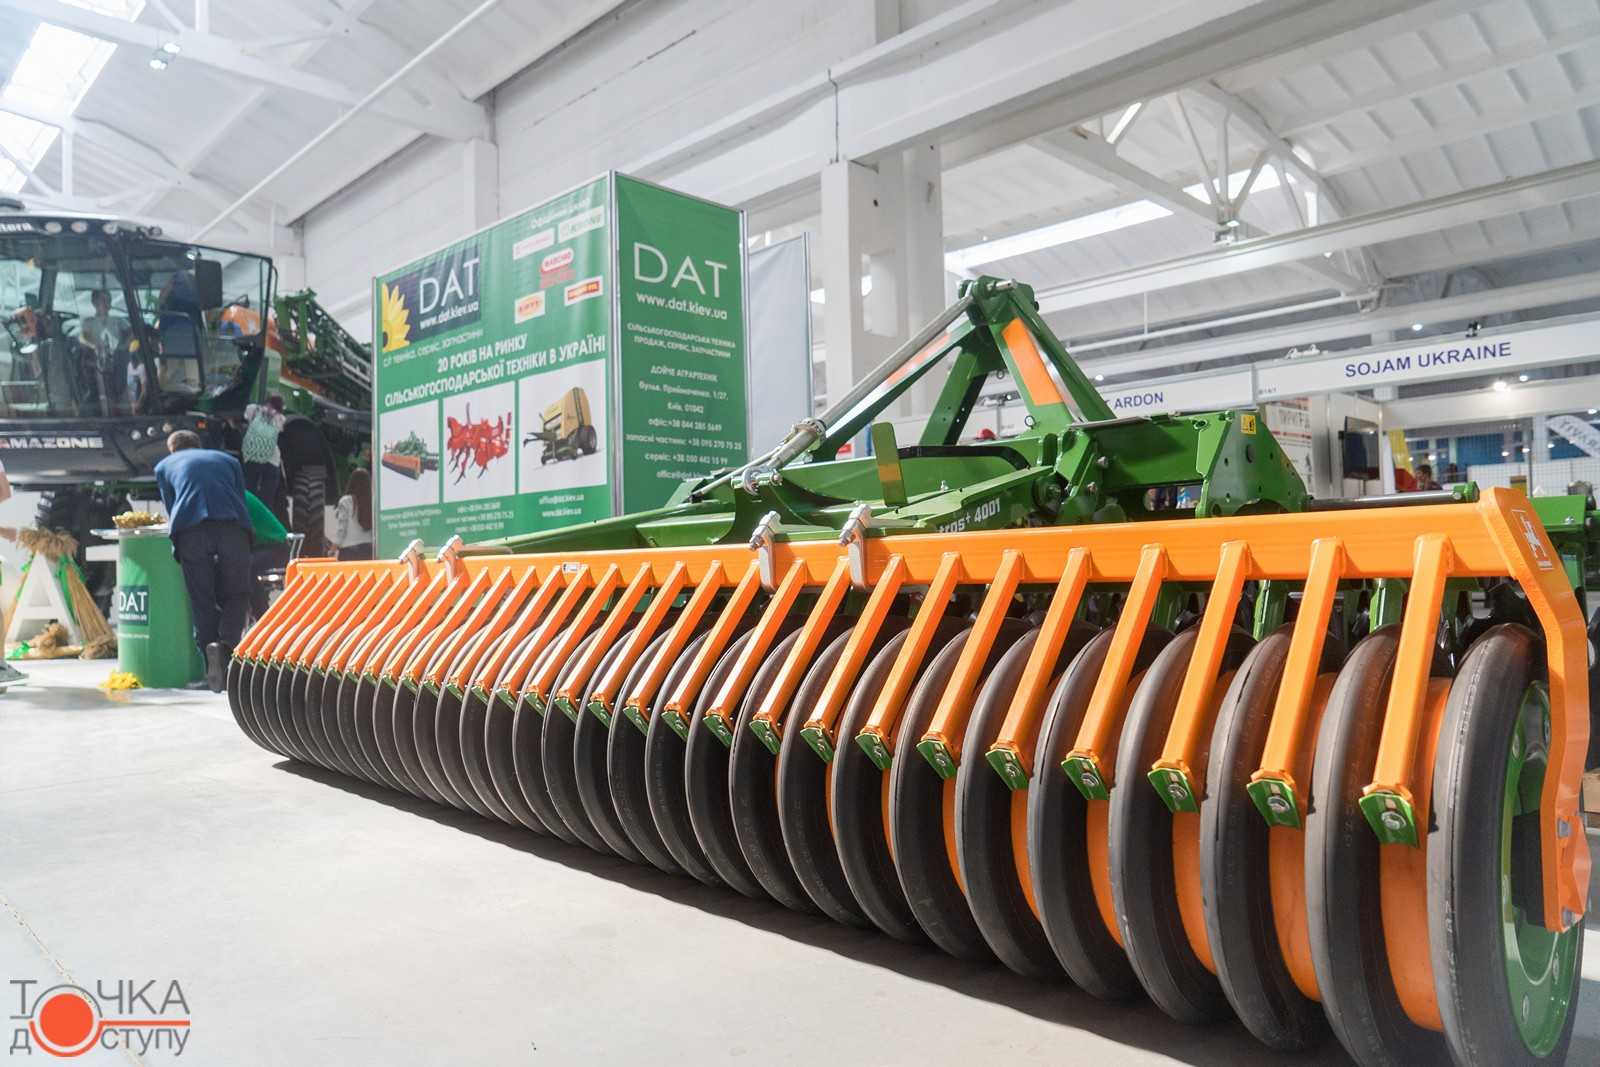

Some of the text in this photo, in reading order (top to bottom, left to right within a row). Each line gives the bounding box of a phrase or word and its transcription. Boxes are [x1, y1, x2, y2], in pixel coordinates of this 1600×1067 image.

[633, 242, 728, 298] DAT
[419, 257, 480, 315] DAT
[419, 301, 479, 330] www.dat.kiev.ua
[636, 292, 728, 320] www.dat.kiev.ua
[437, 333, 528, 373] 20 РОКІВ НА РИНКУ
[1345, 341, 1512, 378] SOJAM UKRAINE
[384, 334, 606, 407] СІЛЬСЬКОГОСПОДАРСЬКОЇ ТЕХНІКИ В УКРАЇНІ
[1114, 391, 1164, 410] ARDON
[0, 437, 104, 449] AMAZONE
[974, 497, 1001, 522] 4001
[118, 591, 148, 612] DAT
